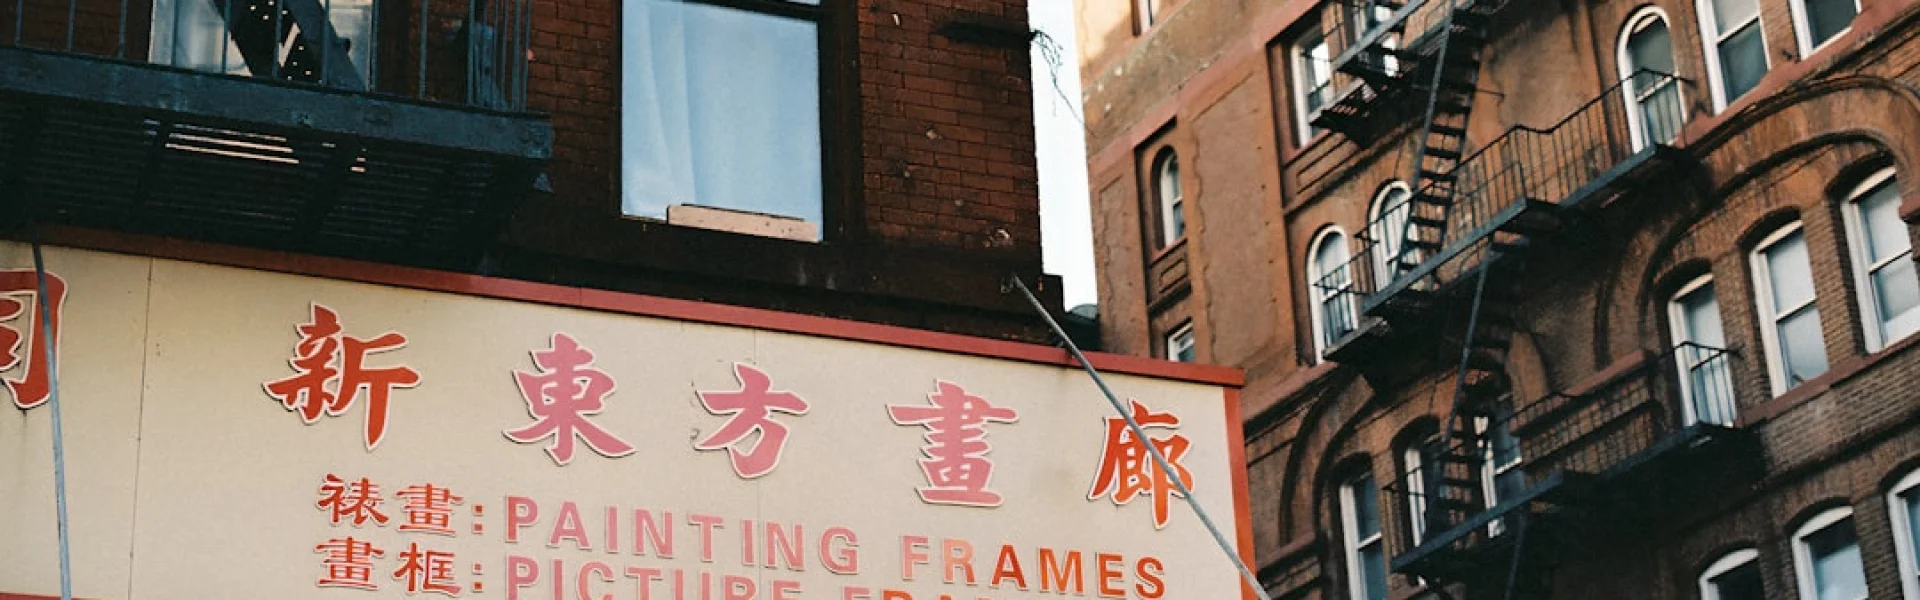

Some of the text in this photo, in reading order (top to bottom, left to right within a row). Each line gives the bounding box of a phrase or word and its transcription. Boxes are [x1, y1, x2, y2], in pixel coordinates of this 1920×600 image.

[263, 302, 1195, 529] 新東方畫廊
[504, 494, 860, 575] PAINTING
[900, 534, 1167, 599] FRAMES
